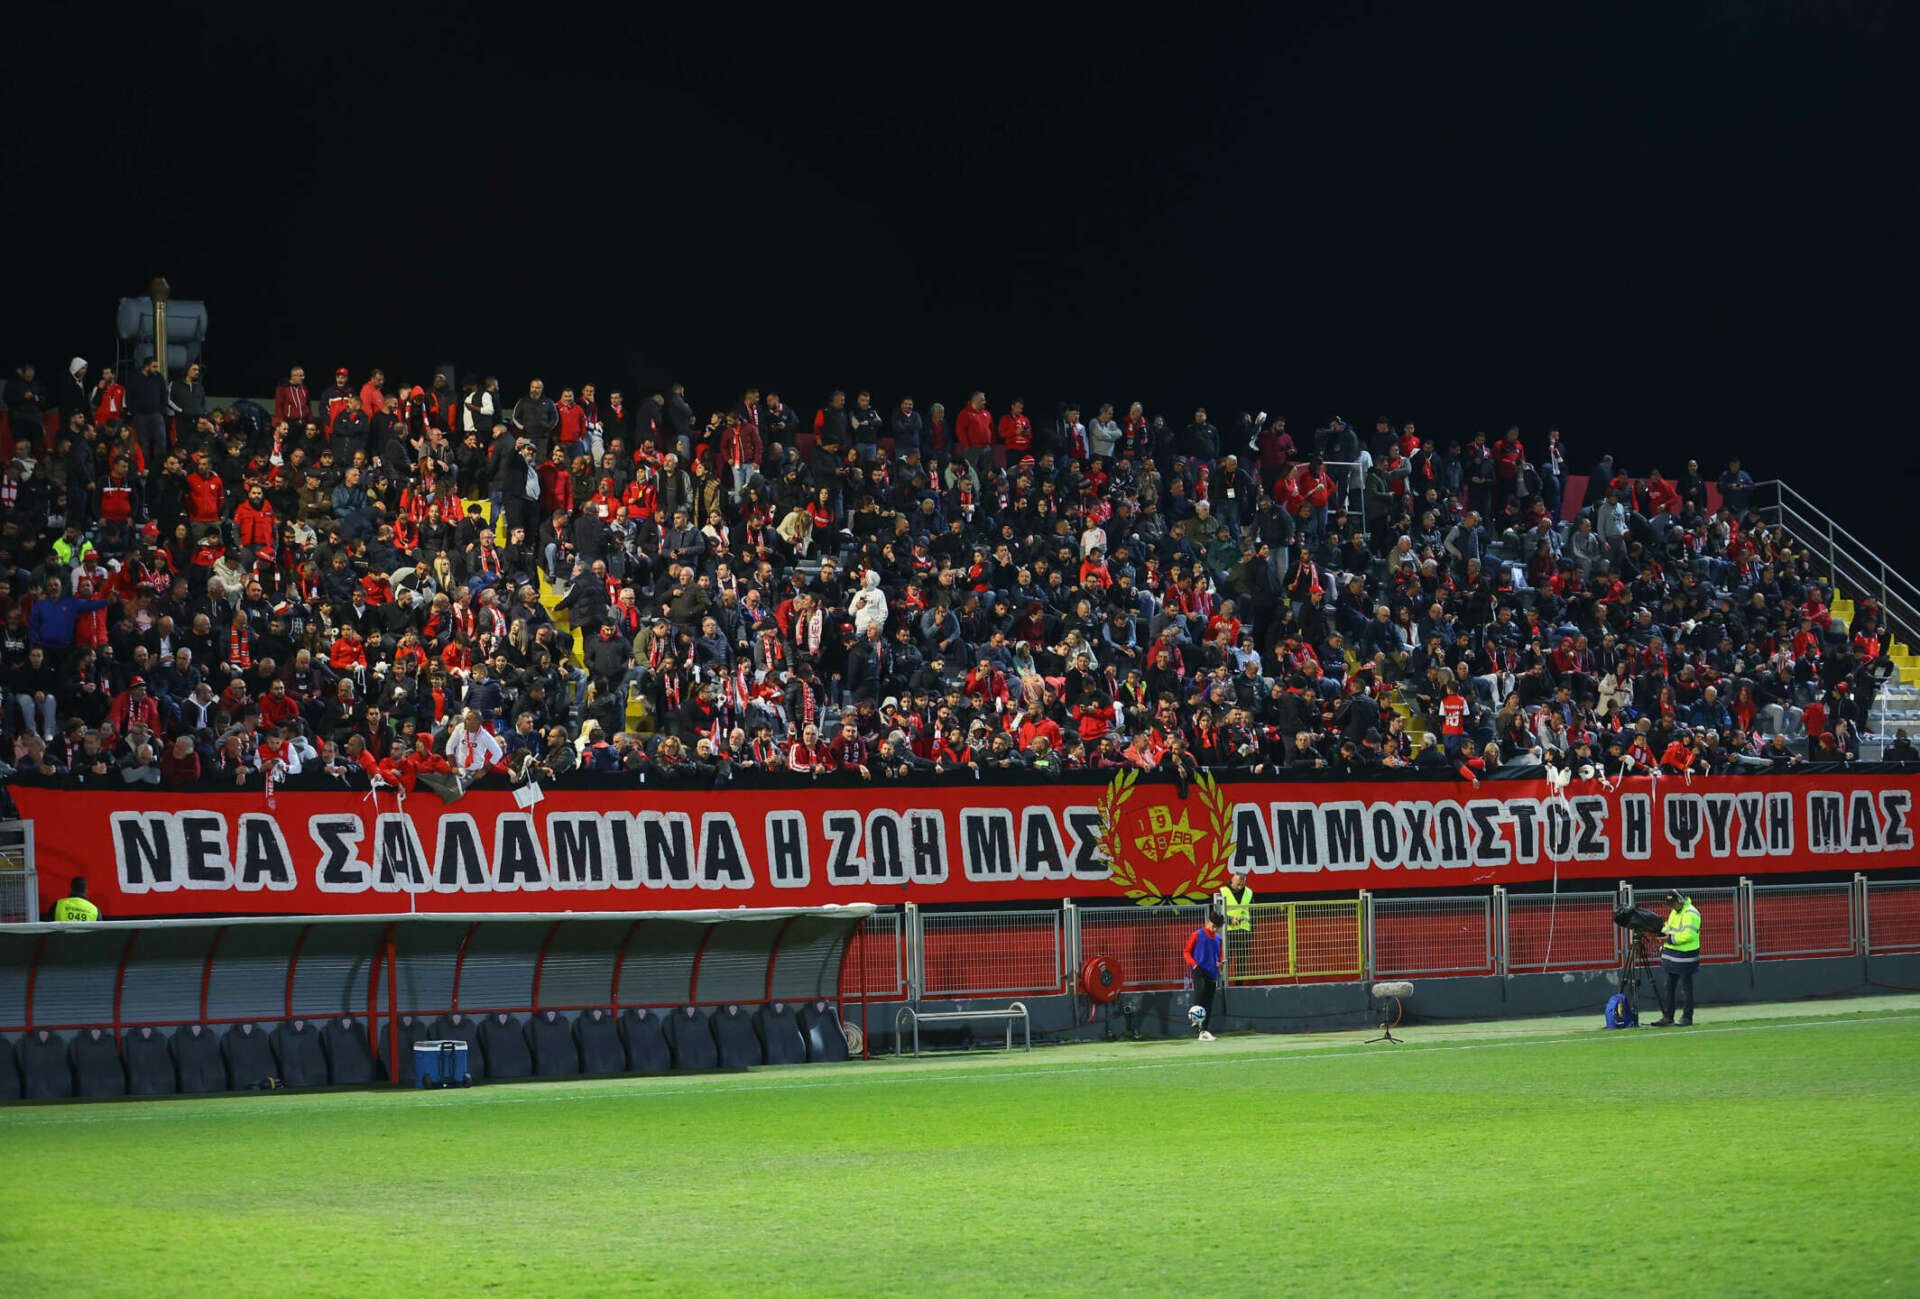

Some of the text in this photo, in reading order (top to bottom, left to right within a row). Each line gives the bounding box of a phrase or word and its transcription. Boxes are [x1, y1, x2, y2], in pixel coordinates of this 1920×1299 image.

[110, 806, 1114, 894] ΝΕΑ ΣΑΛΑΜΙΝΑ Η ΖΩΗ ΜΑΣ
[1227, 790, 1915, 876] ΑΜΜΟΧΩΣΤΟΣ Η ΨΥΧΗ ΜΑΣ
